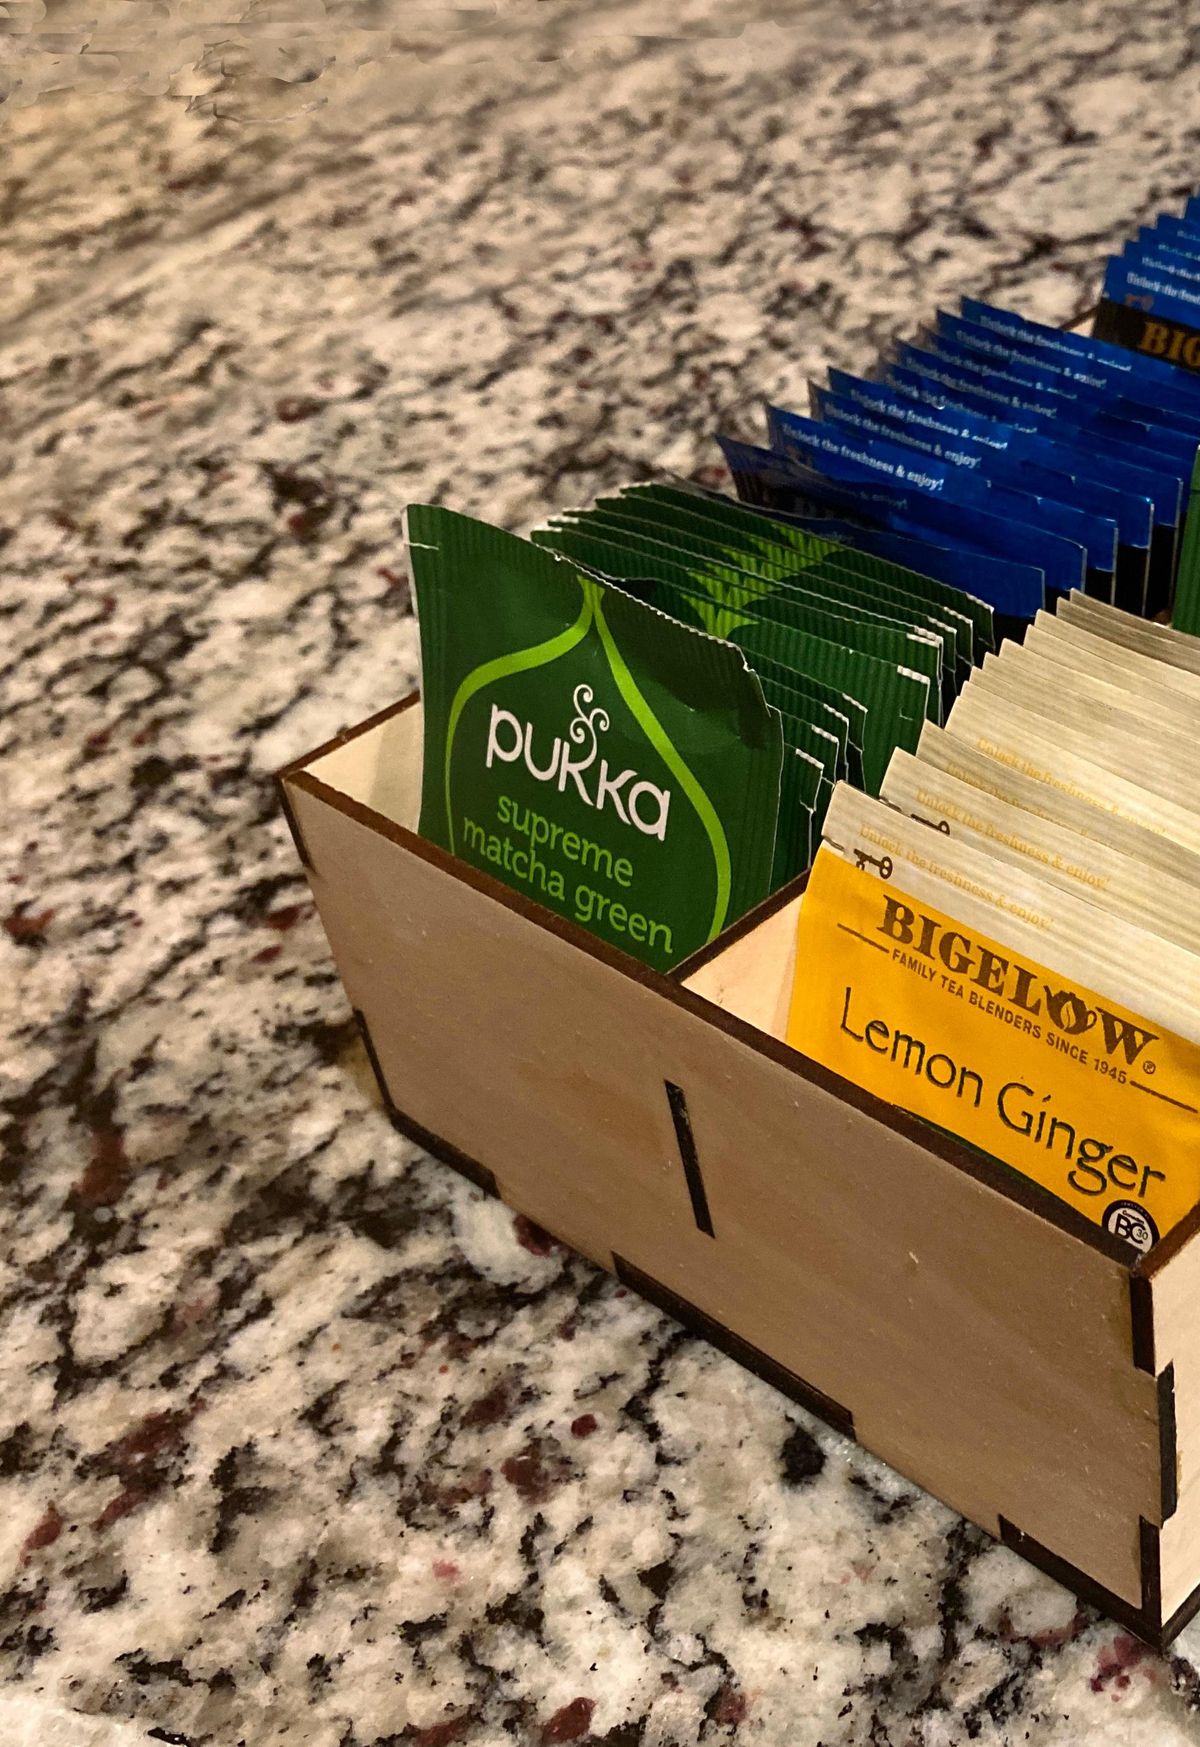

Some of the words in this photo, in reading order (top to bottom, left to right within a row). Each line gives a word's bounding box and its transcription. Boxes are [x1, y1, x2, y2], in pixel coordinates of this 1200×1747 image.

[486, 690, 671, 842] pukka
[463, 816, 565, 901] matcha
[574, 885, 674, 954] green
[497, 793, 633, 888] supreme
[962, 809, 983, 832] the
[985, 821, 1051, 865] freshness
[876, 894, 1159, 1065] BIGELOW
[892, 948, 938, 983] FAMILY
[940, 973, 965, 999] TEA
[968, 992, 1042, 1039] BLENDERS
[1045, 1031, 1089, 1065] SINCE
[1093, 1057, 1128, 1086] 1945
[840, 986, 984, 1109] Lemon
[996, 1078, 1168, 1197] Ginger
